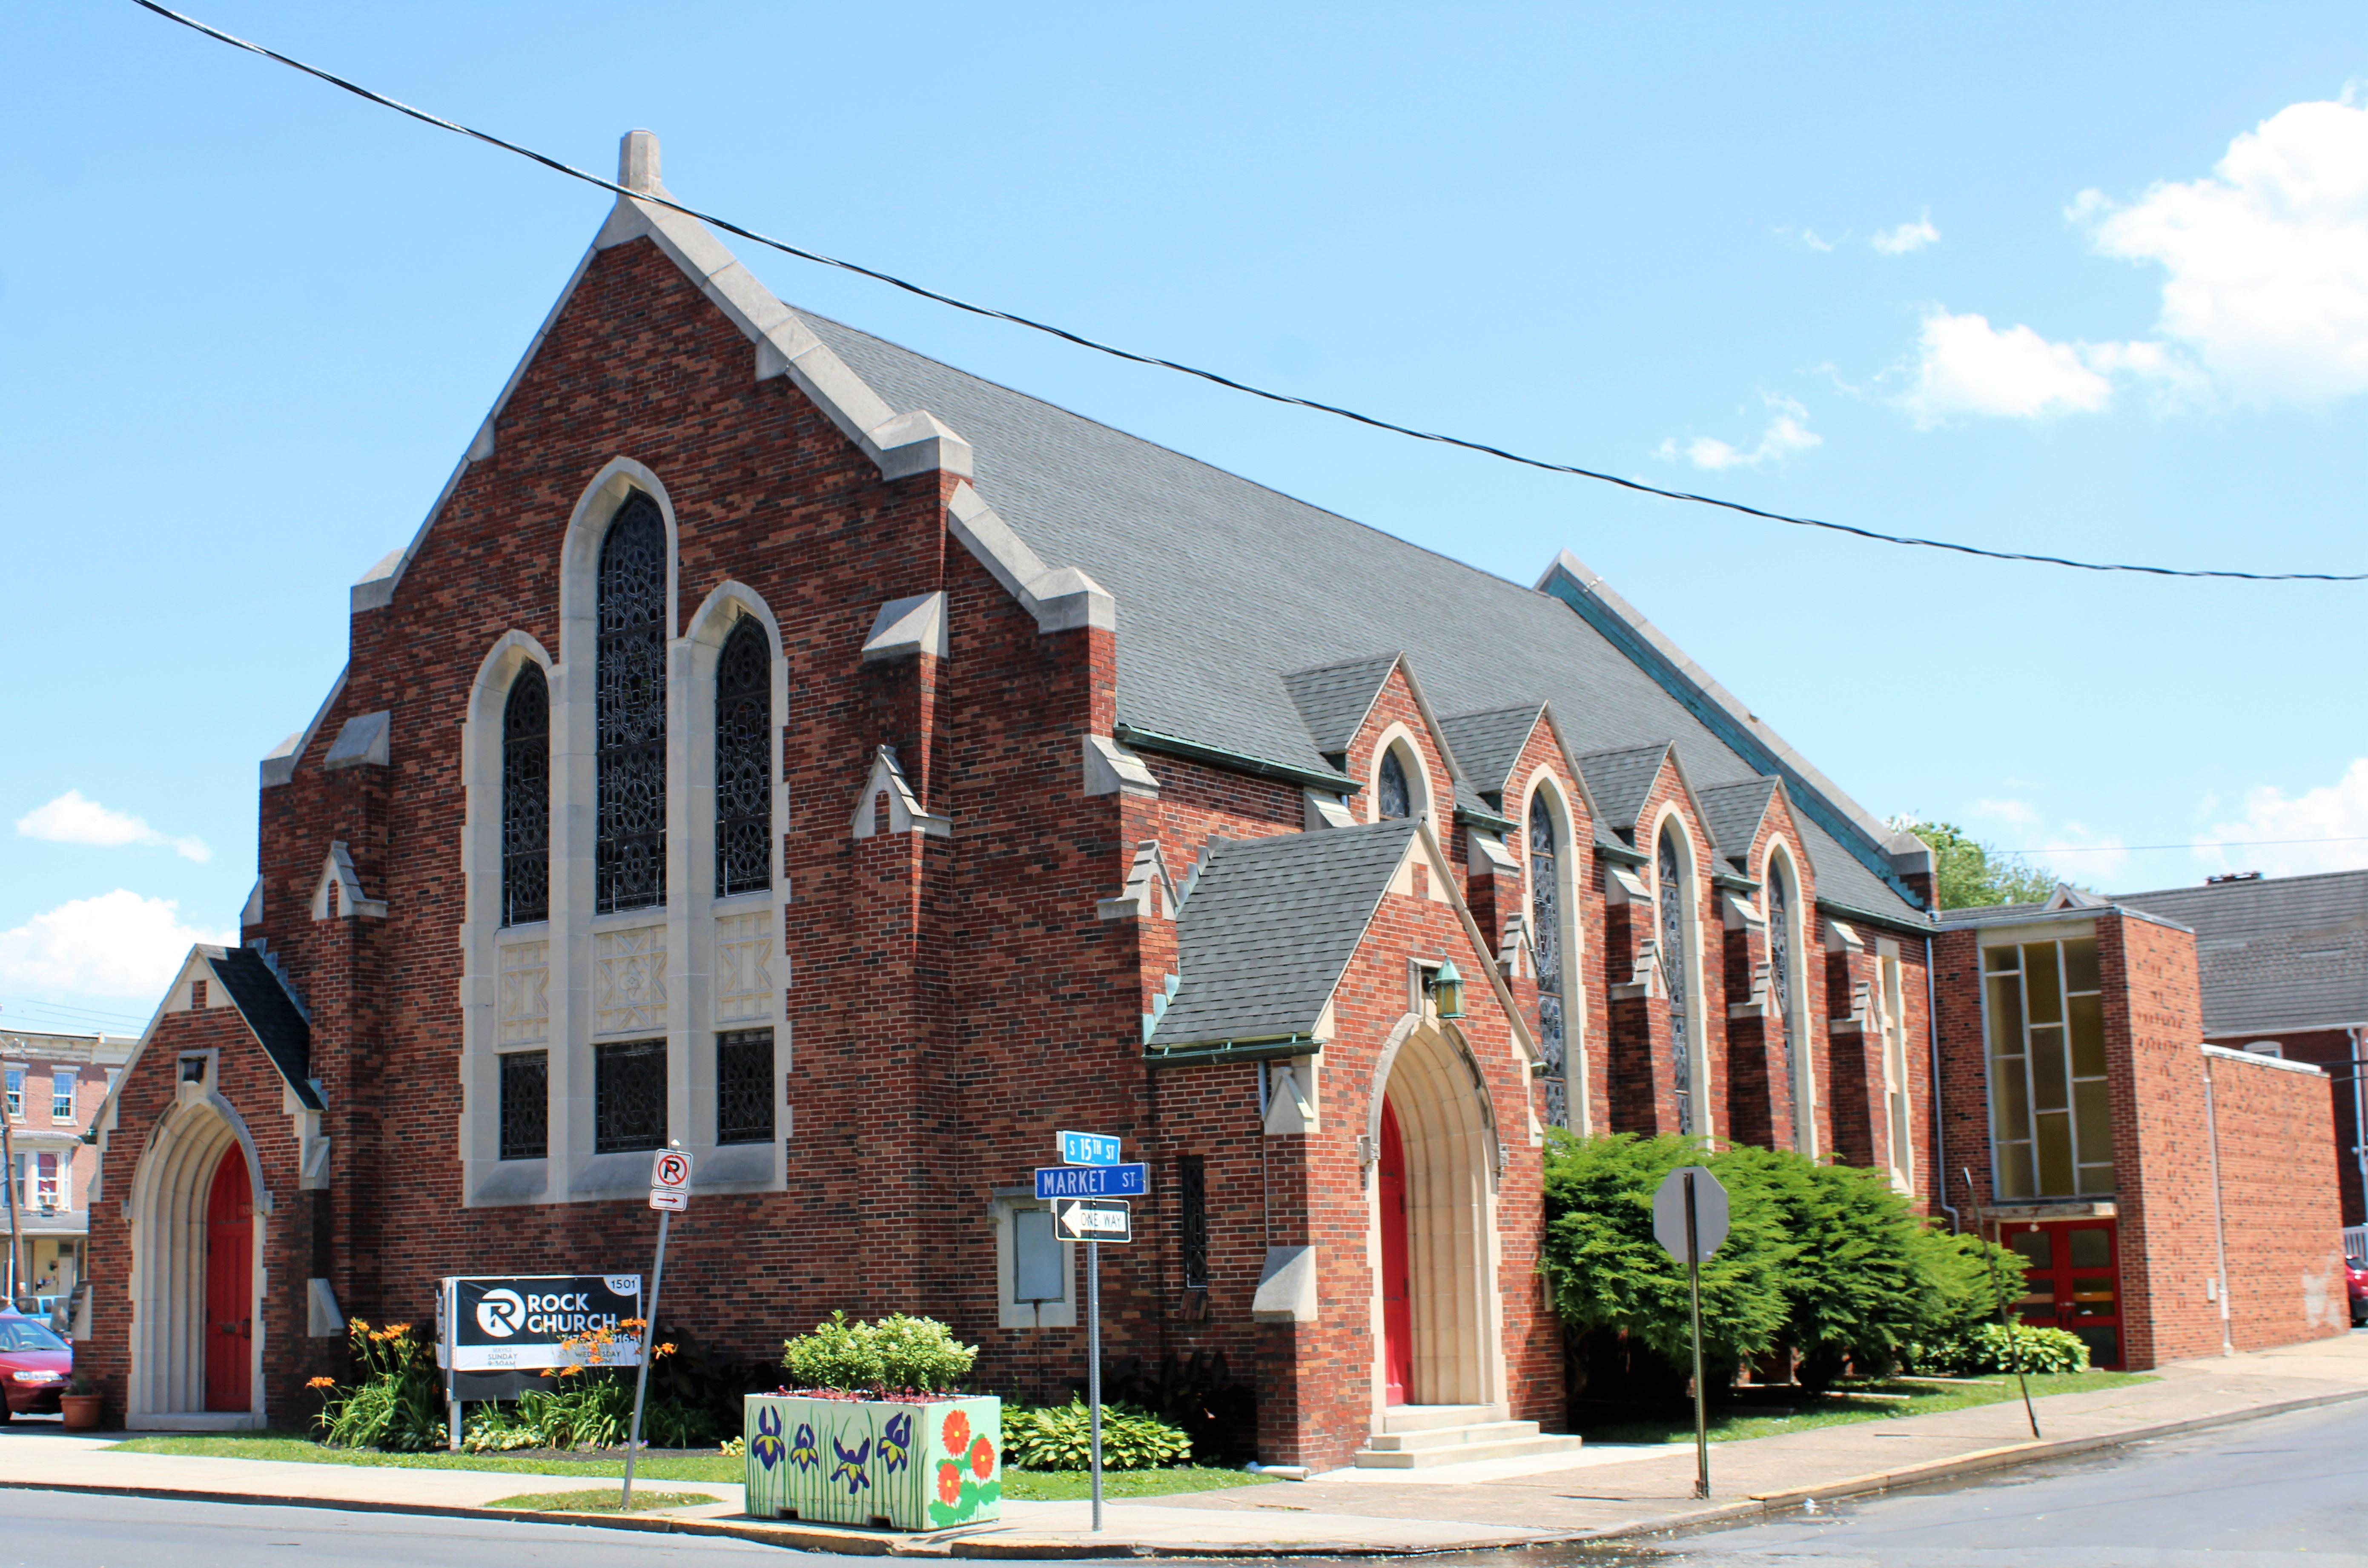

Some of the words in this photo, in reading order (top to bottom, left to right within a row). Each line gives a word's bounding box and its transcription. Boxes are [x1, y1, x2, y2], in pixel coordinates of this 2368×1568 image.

[1069, 1140, 1075, 1156] S
[1080, 1138, 1102, 1161] 15TH
[1106, 1144, 1115, 1160] ST
[1044, 1170, 1107, 1195] MARKET
[1122, 1172, 1135, 1187] ST
[1081, 1212, 1098, 1227] ONE
[1103, 1213, 1122, 1228] WAY
[611, 1279, 636, 1289] 1501
[527, 1293, 590, 1313] ROCK
[527, 1313, 616, 1333] CHURCH
